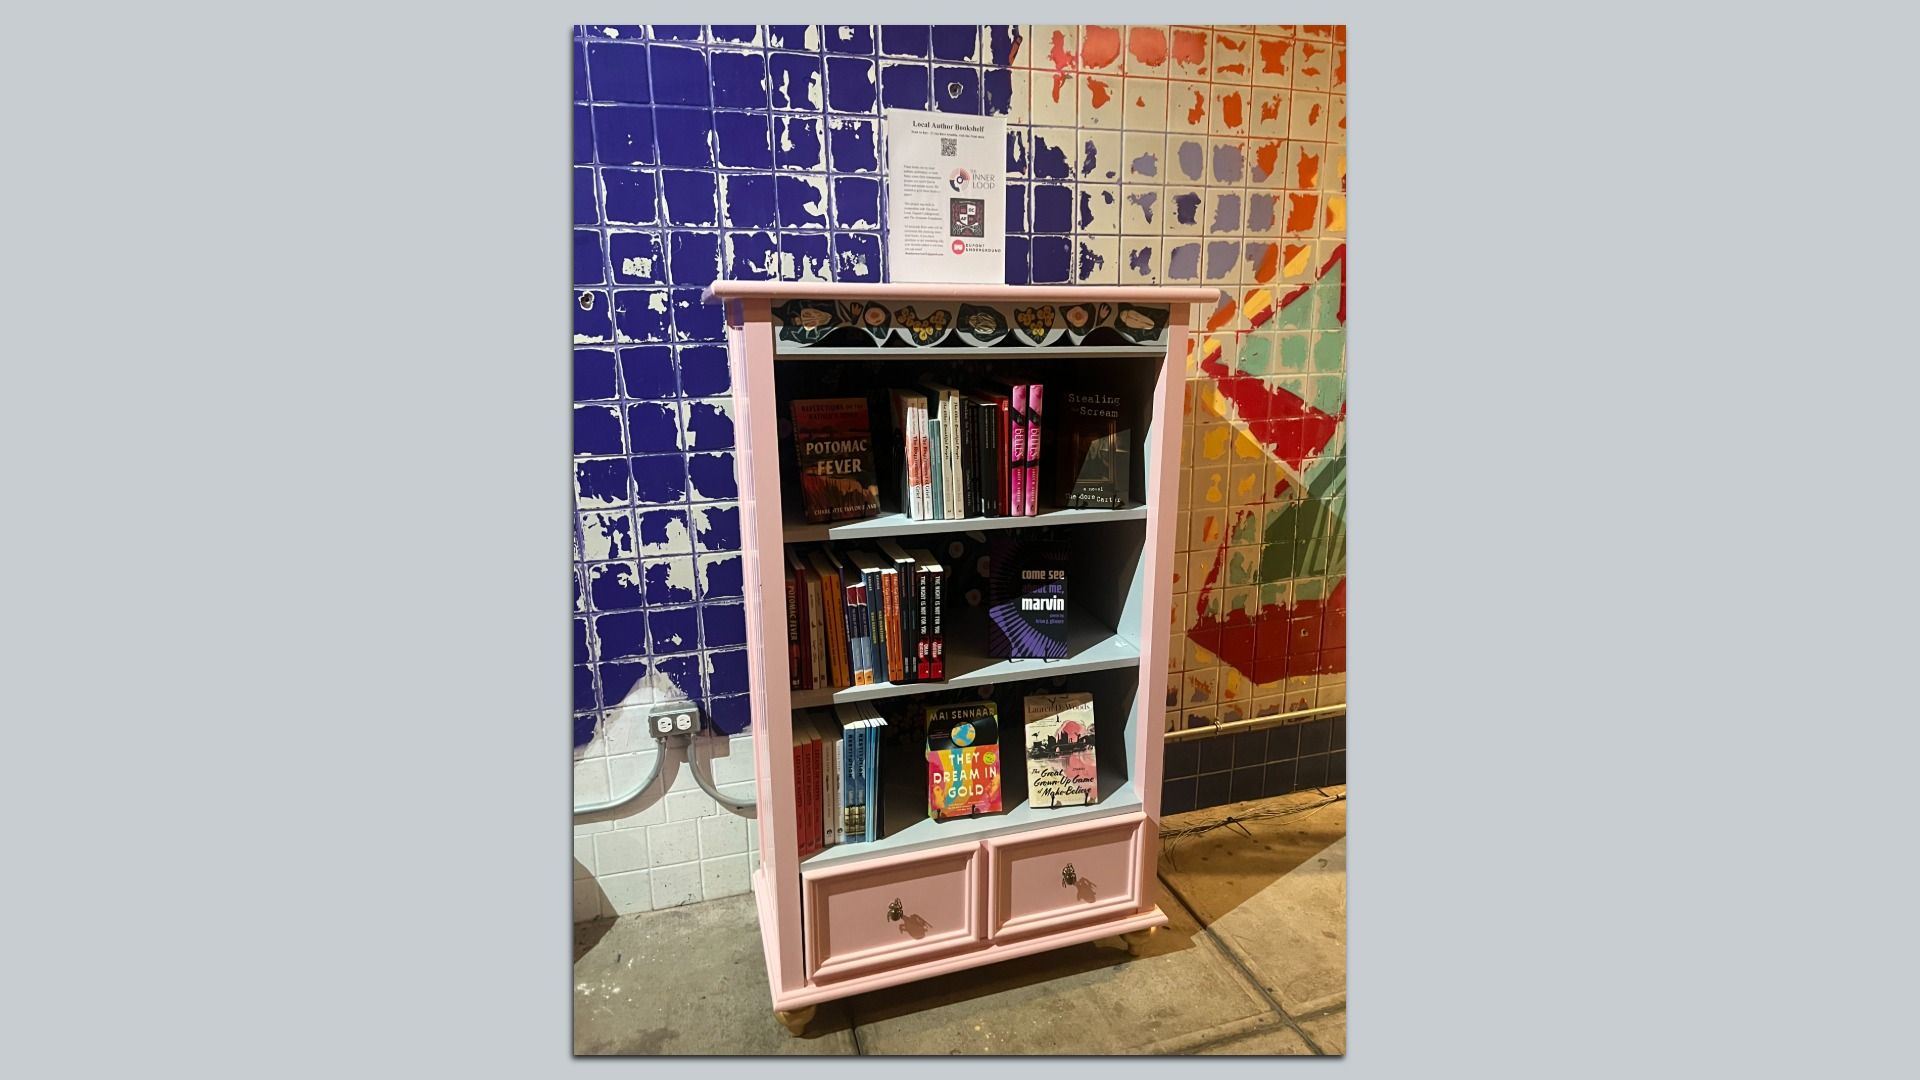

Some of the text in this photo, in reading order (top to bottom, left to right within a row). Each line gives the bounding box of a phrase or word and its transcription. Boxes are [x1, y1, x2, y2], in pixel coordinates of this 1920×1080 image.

[912, 120, 985, 132] Local Author Bookshelf
[1068, 392, 1120, 406] Stealing
[1080, 406, 1119, 418] Scream
[806, 439, 868, 455] POTOMAC
[817, 458, 862, 475] FEVER
[1065, 492, 1121, 503] Thedore Cartr
[814, 506, 842, 516] CHARLTTE
[1022, 569, 1065, 580] come see
[1048, 584, 1065, 595] me,
[787, 585, 797, 620] POTOMAC
[1021, 594, 1065, 611] marvin
[789, 621, 798, 641] FEVER
[930, 707, 994, 721] MAI SENNAAR
[1028, 705, 1054, 714] Lauren
[949, 751, 980, 765] THEY
[933, 766, 997, 784] DREAM IN
[1040, 768, 1063, 777] Great
[1033, 774, 1094, 787] Grown-Up Game
[948, 784, 984, 798] GOLD
[1042, 785, 1091, 797] Make-Believe
